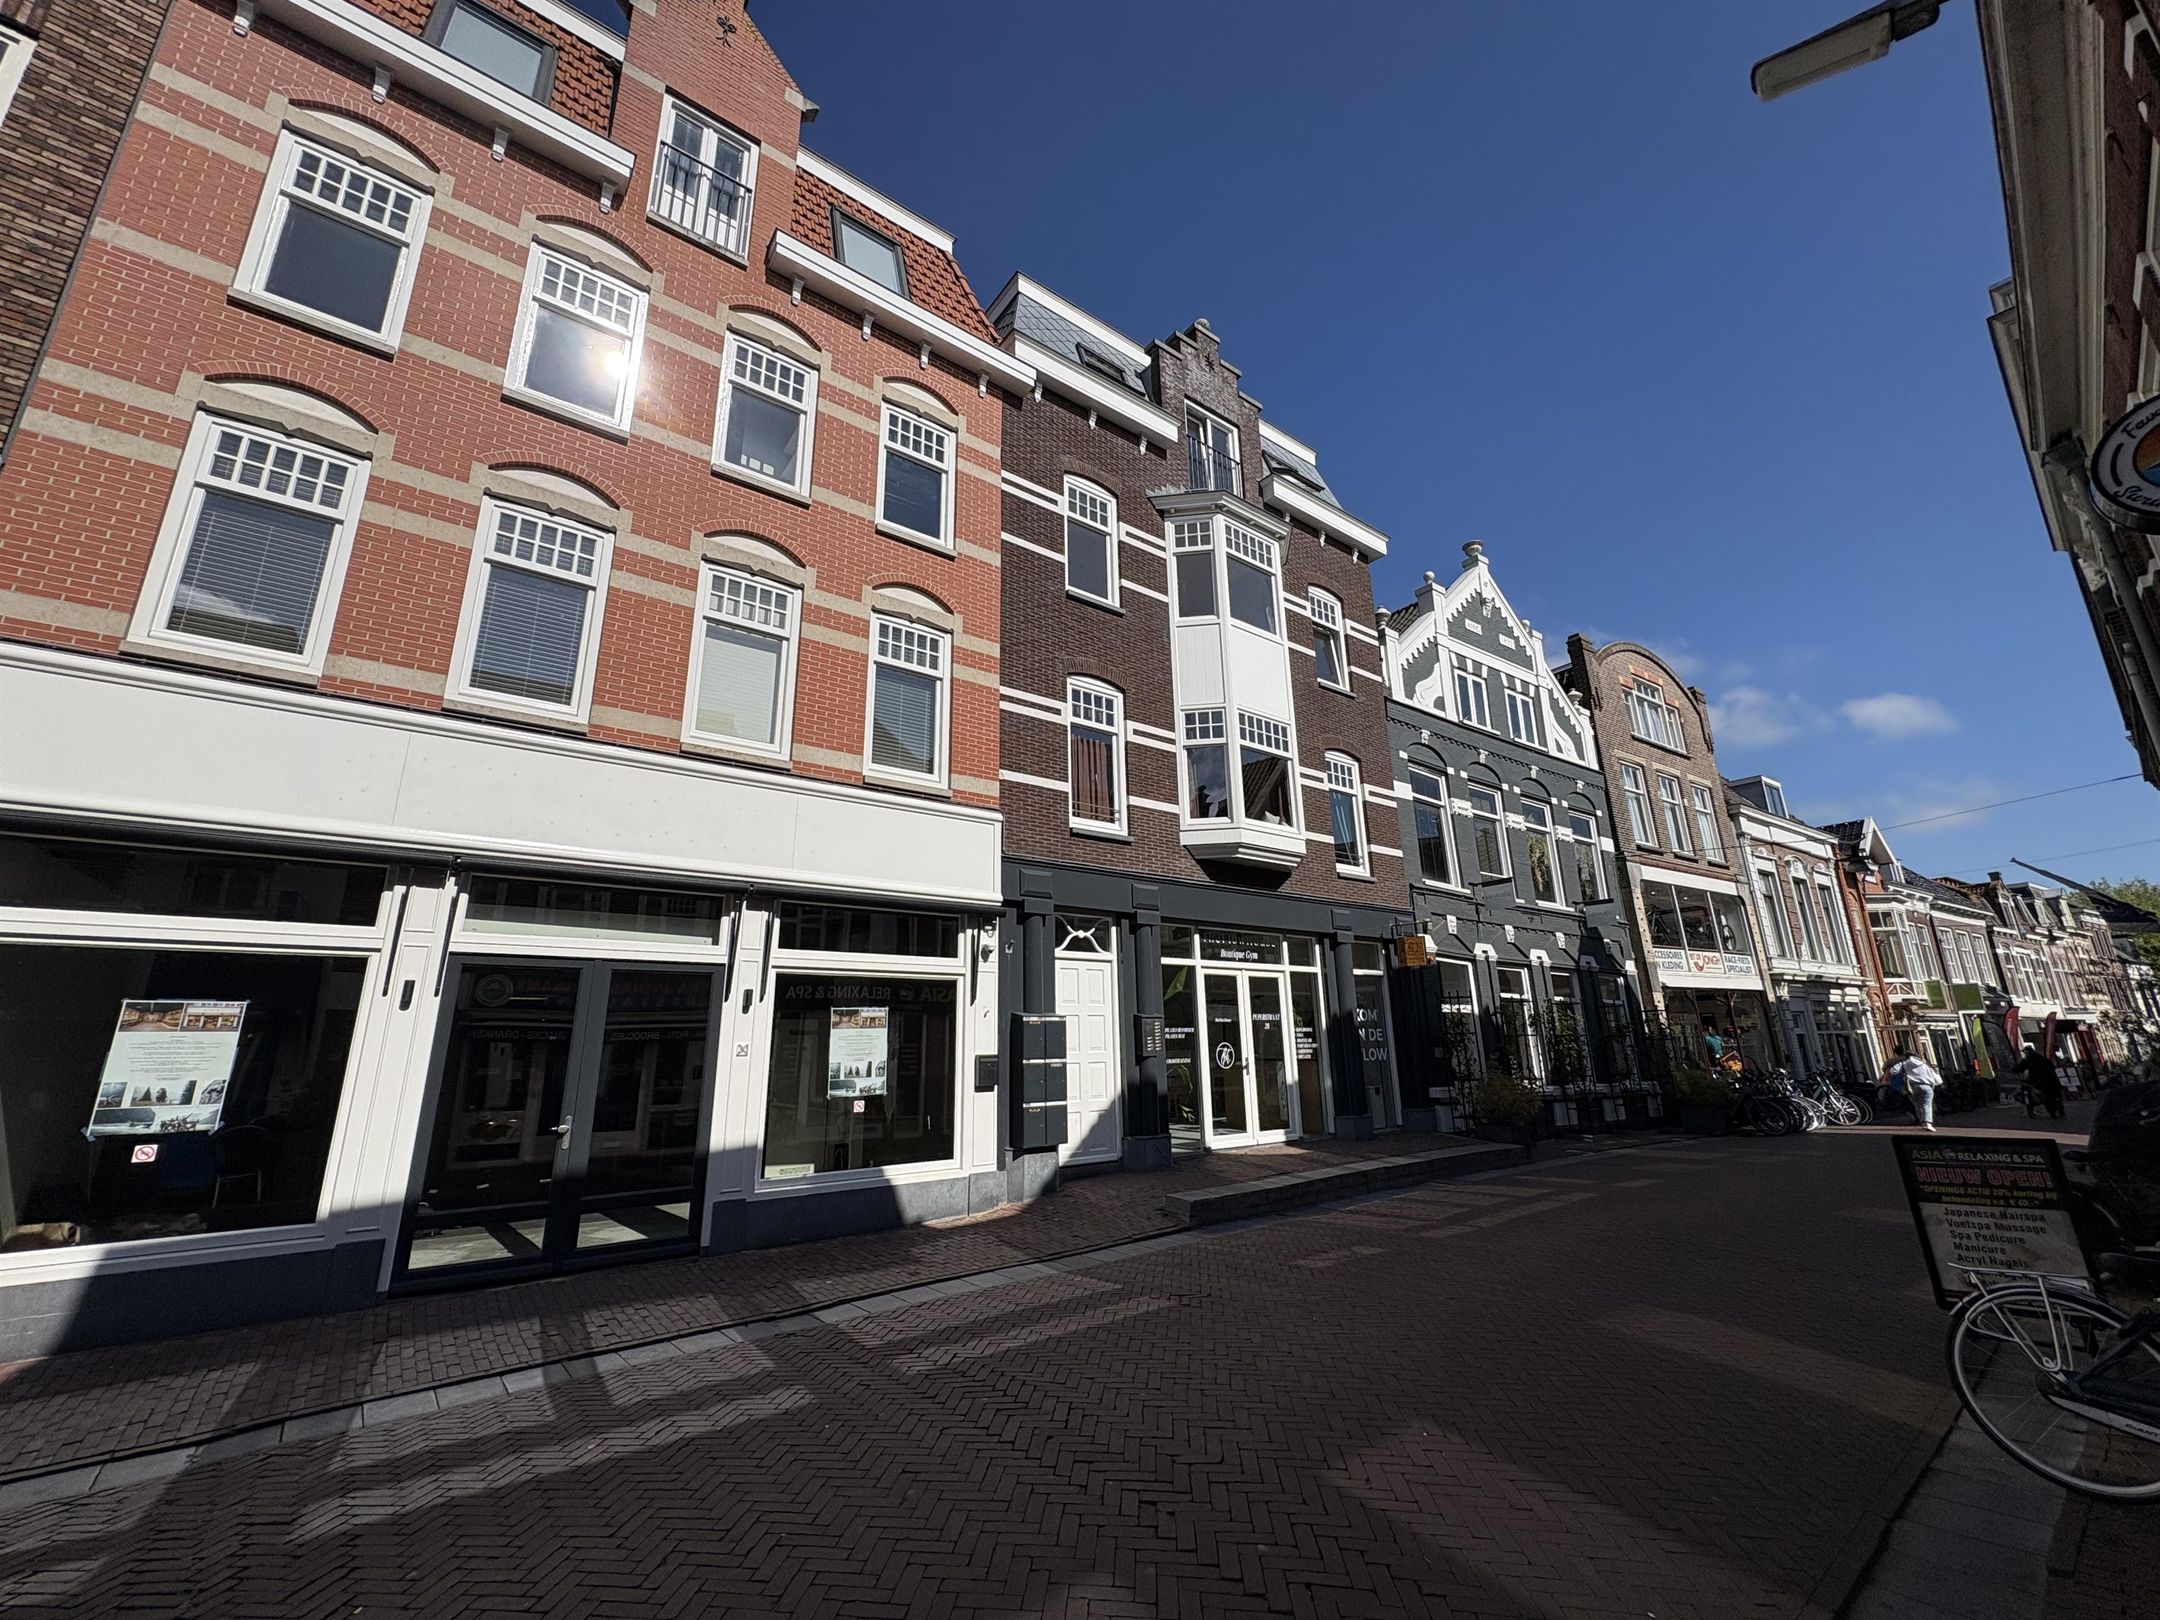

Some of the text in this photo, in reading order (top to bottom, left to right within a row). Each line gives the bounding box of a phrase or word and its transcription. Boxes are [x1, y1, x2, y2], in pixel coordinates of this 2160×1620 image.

[1220, 948, 1259, 961] Boutique Gym
[1654, 950, 1683, 960] CCESSOIRES
[1662, 960, 1684, 970] KLEDING
[1726, 964, 1753, 974] SPECIALIST
[1368, 1028, 1384, 1041] DE
[1362, 1047, 1388, 1061] LOW
[1911, 1149, 2045, 1164] ASIA RELAXING & SPA
[1915, 1166, 2054, 1187] NIEUW OPEN!
[1967, 1187, 1991, 1195] ACTIE
[1943, 1207, 2046, 1223] Japanese Hairspa
[1945, 1218, 2048, 1235] Voetspa Massage
[1949, 1230, 2026, 1244] Spa Pedicure
[1953, 1242, 2007, 1255] Manicure
[1957, 1253, 2030, 1268] Acryl Nagels
